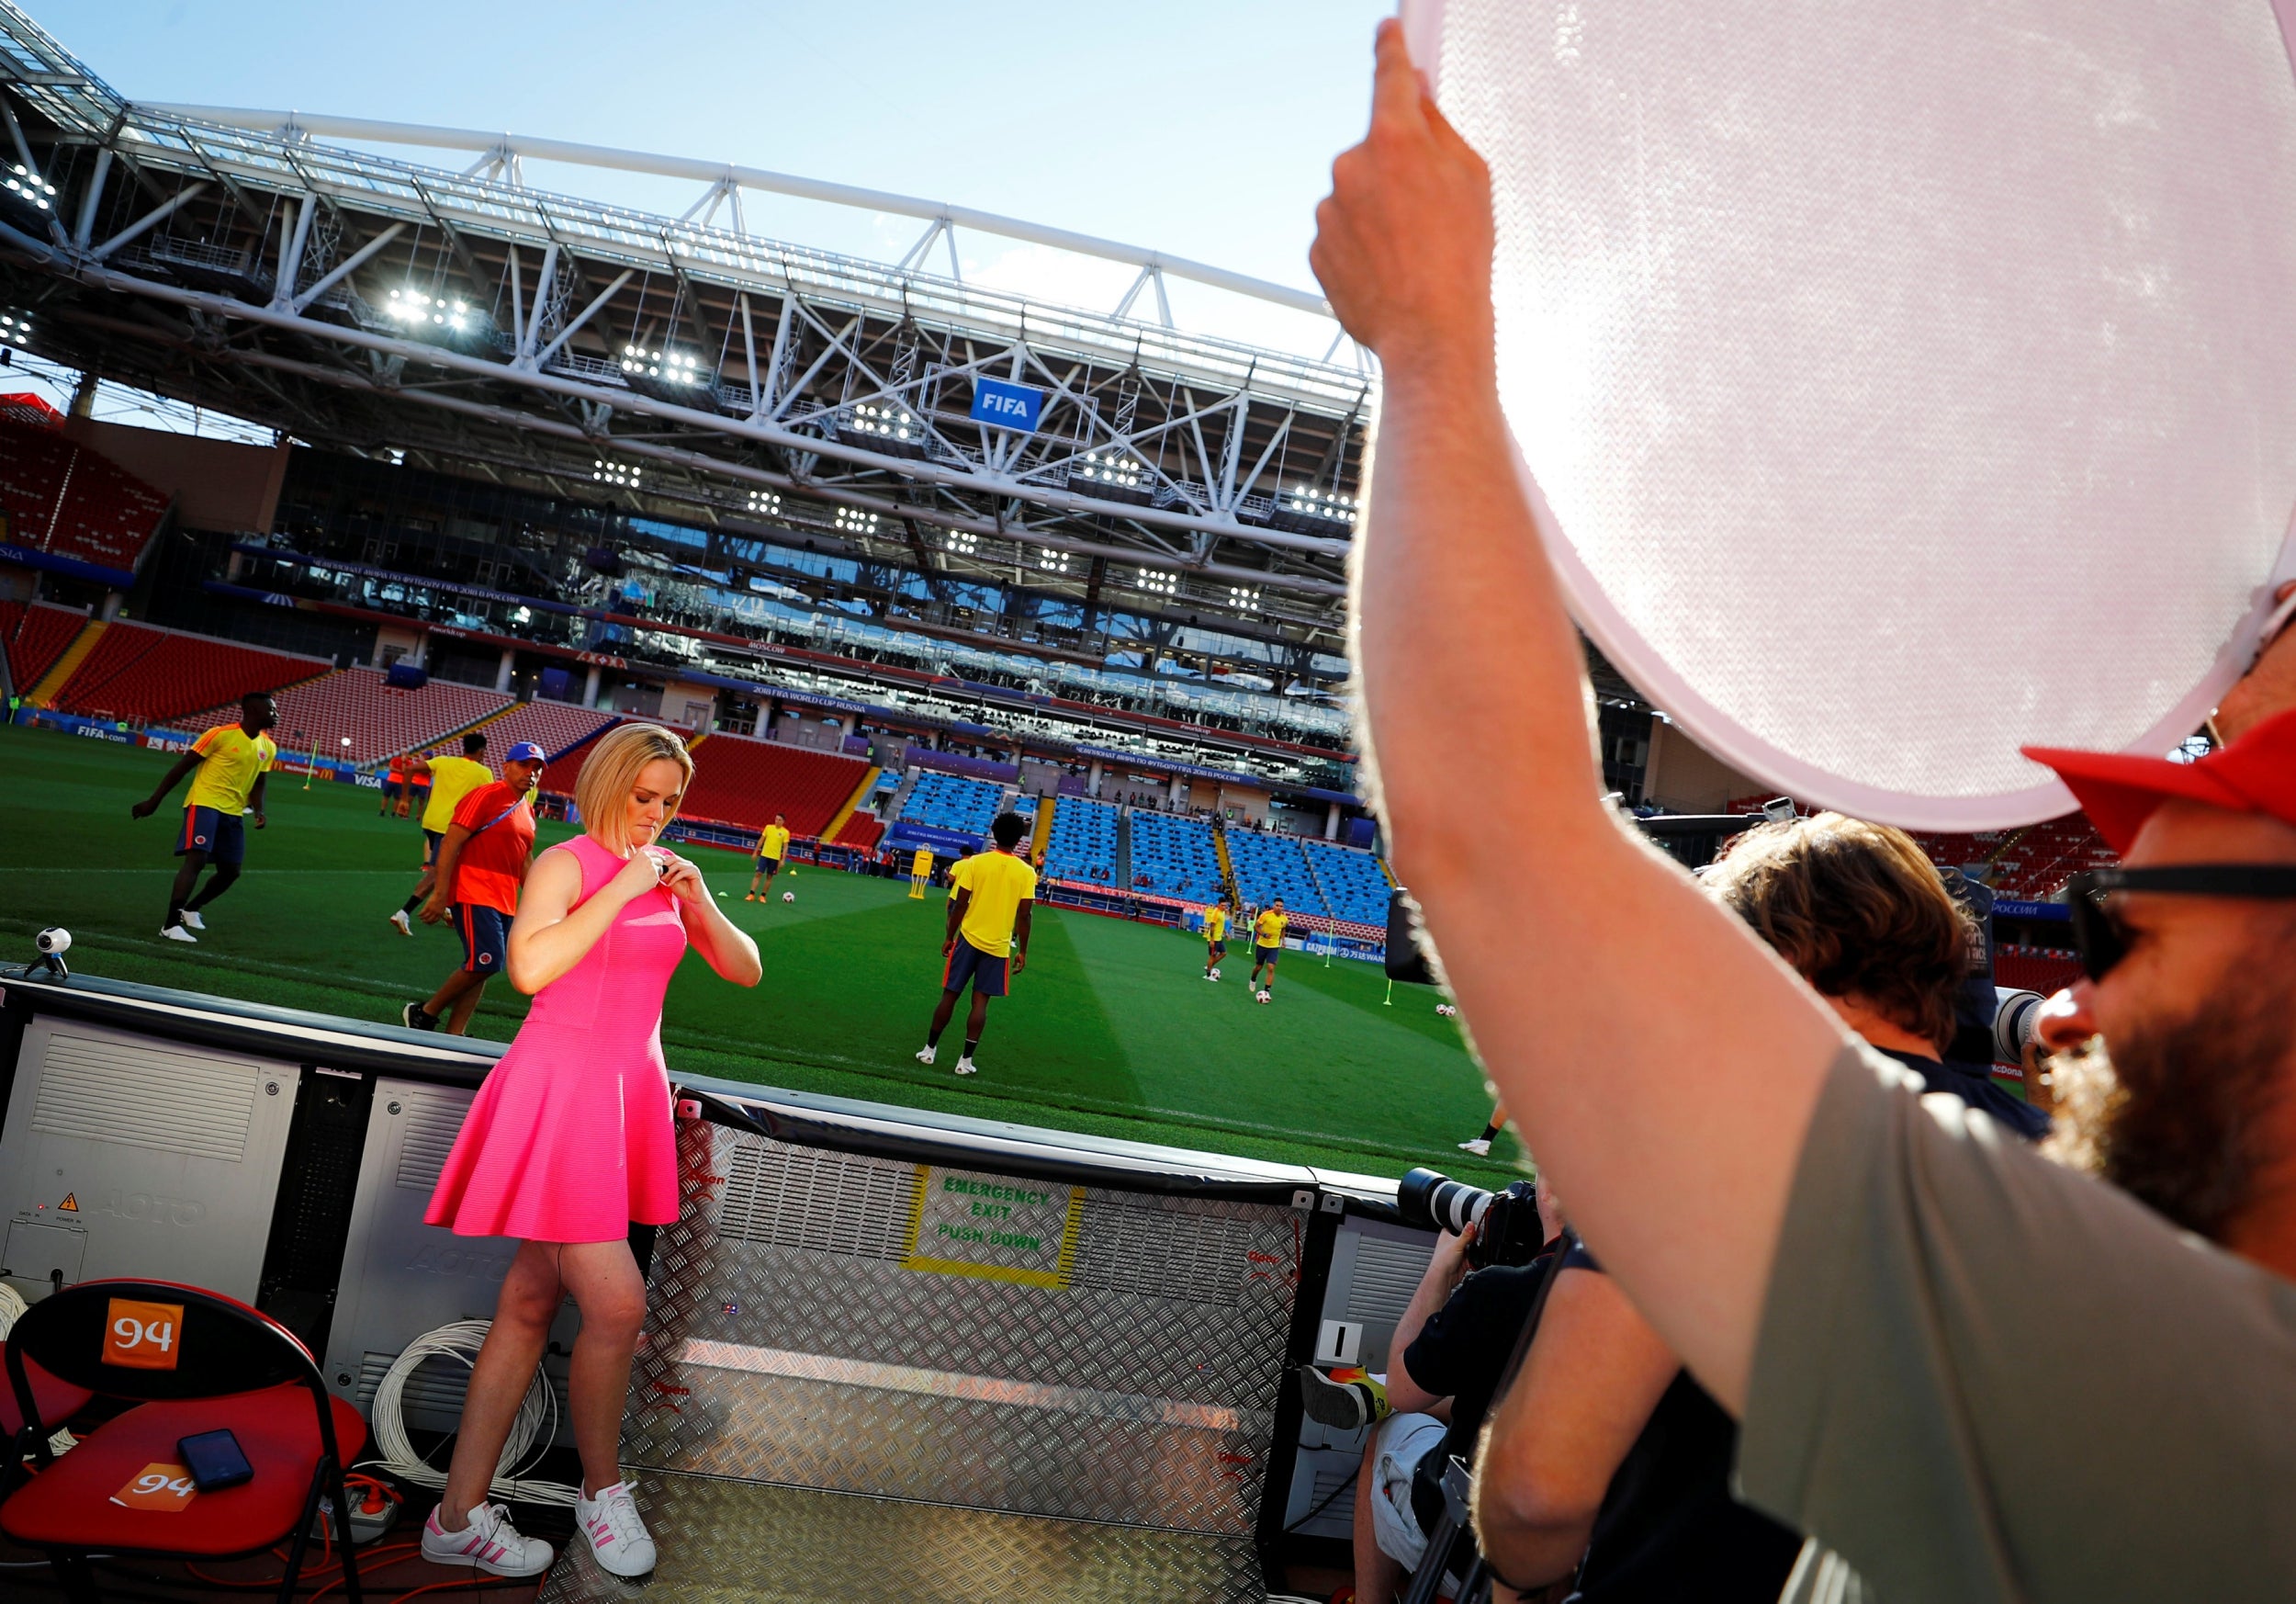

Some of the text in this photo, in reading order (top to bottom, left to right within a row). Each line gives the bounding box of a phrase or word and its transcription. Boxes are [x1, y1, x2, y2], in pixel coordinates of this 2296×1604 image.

[983, 393, 1028, 418] FIFA
[748, 641, 785, 654] MOSCOW
[753, 685, 865, 713] 2018 FIFA WORLD CUP RUSSIA
[77, 726, 127, 743] FIFA.com
[1076, 746, 1115, 760] ЧЕМПИОНАТ
[1117, 753, 1135, 763] МИРА
[1137, 756, 1147, 765] ПО
[1147, 759, 1177, 772] ФУТБОЛУ
[1178, 765, 1192, 774] FIFA
[1193, 768, 1208, 777] 2018
[1213, 772, 1242, 783] РОССИИ
[353, 774, 382, 789] VISA
[1991, 900, 2039, 916] РОССИИ
[1367, 954, 1385, 963] WAN
[943, 1175, 1049, 1205] EMERGENCY
[971, 1201, 1011, 1220] EXIT
[938, 1223, 1041, 1251] PUSH DOWN
[114, 1317, 173, 1352] 94
[131, 1474, 197, 1497] 94
